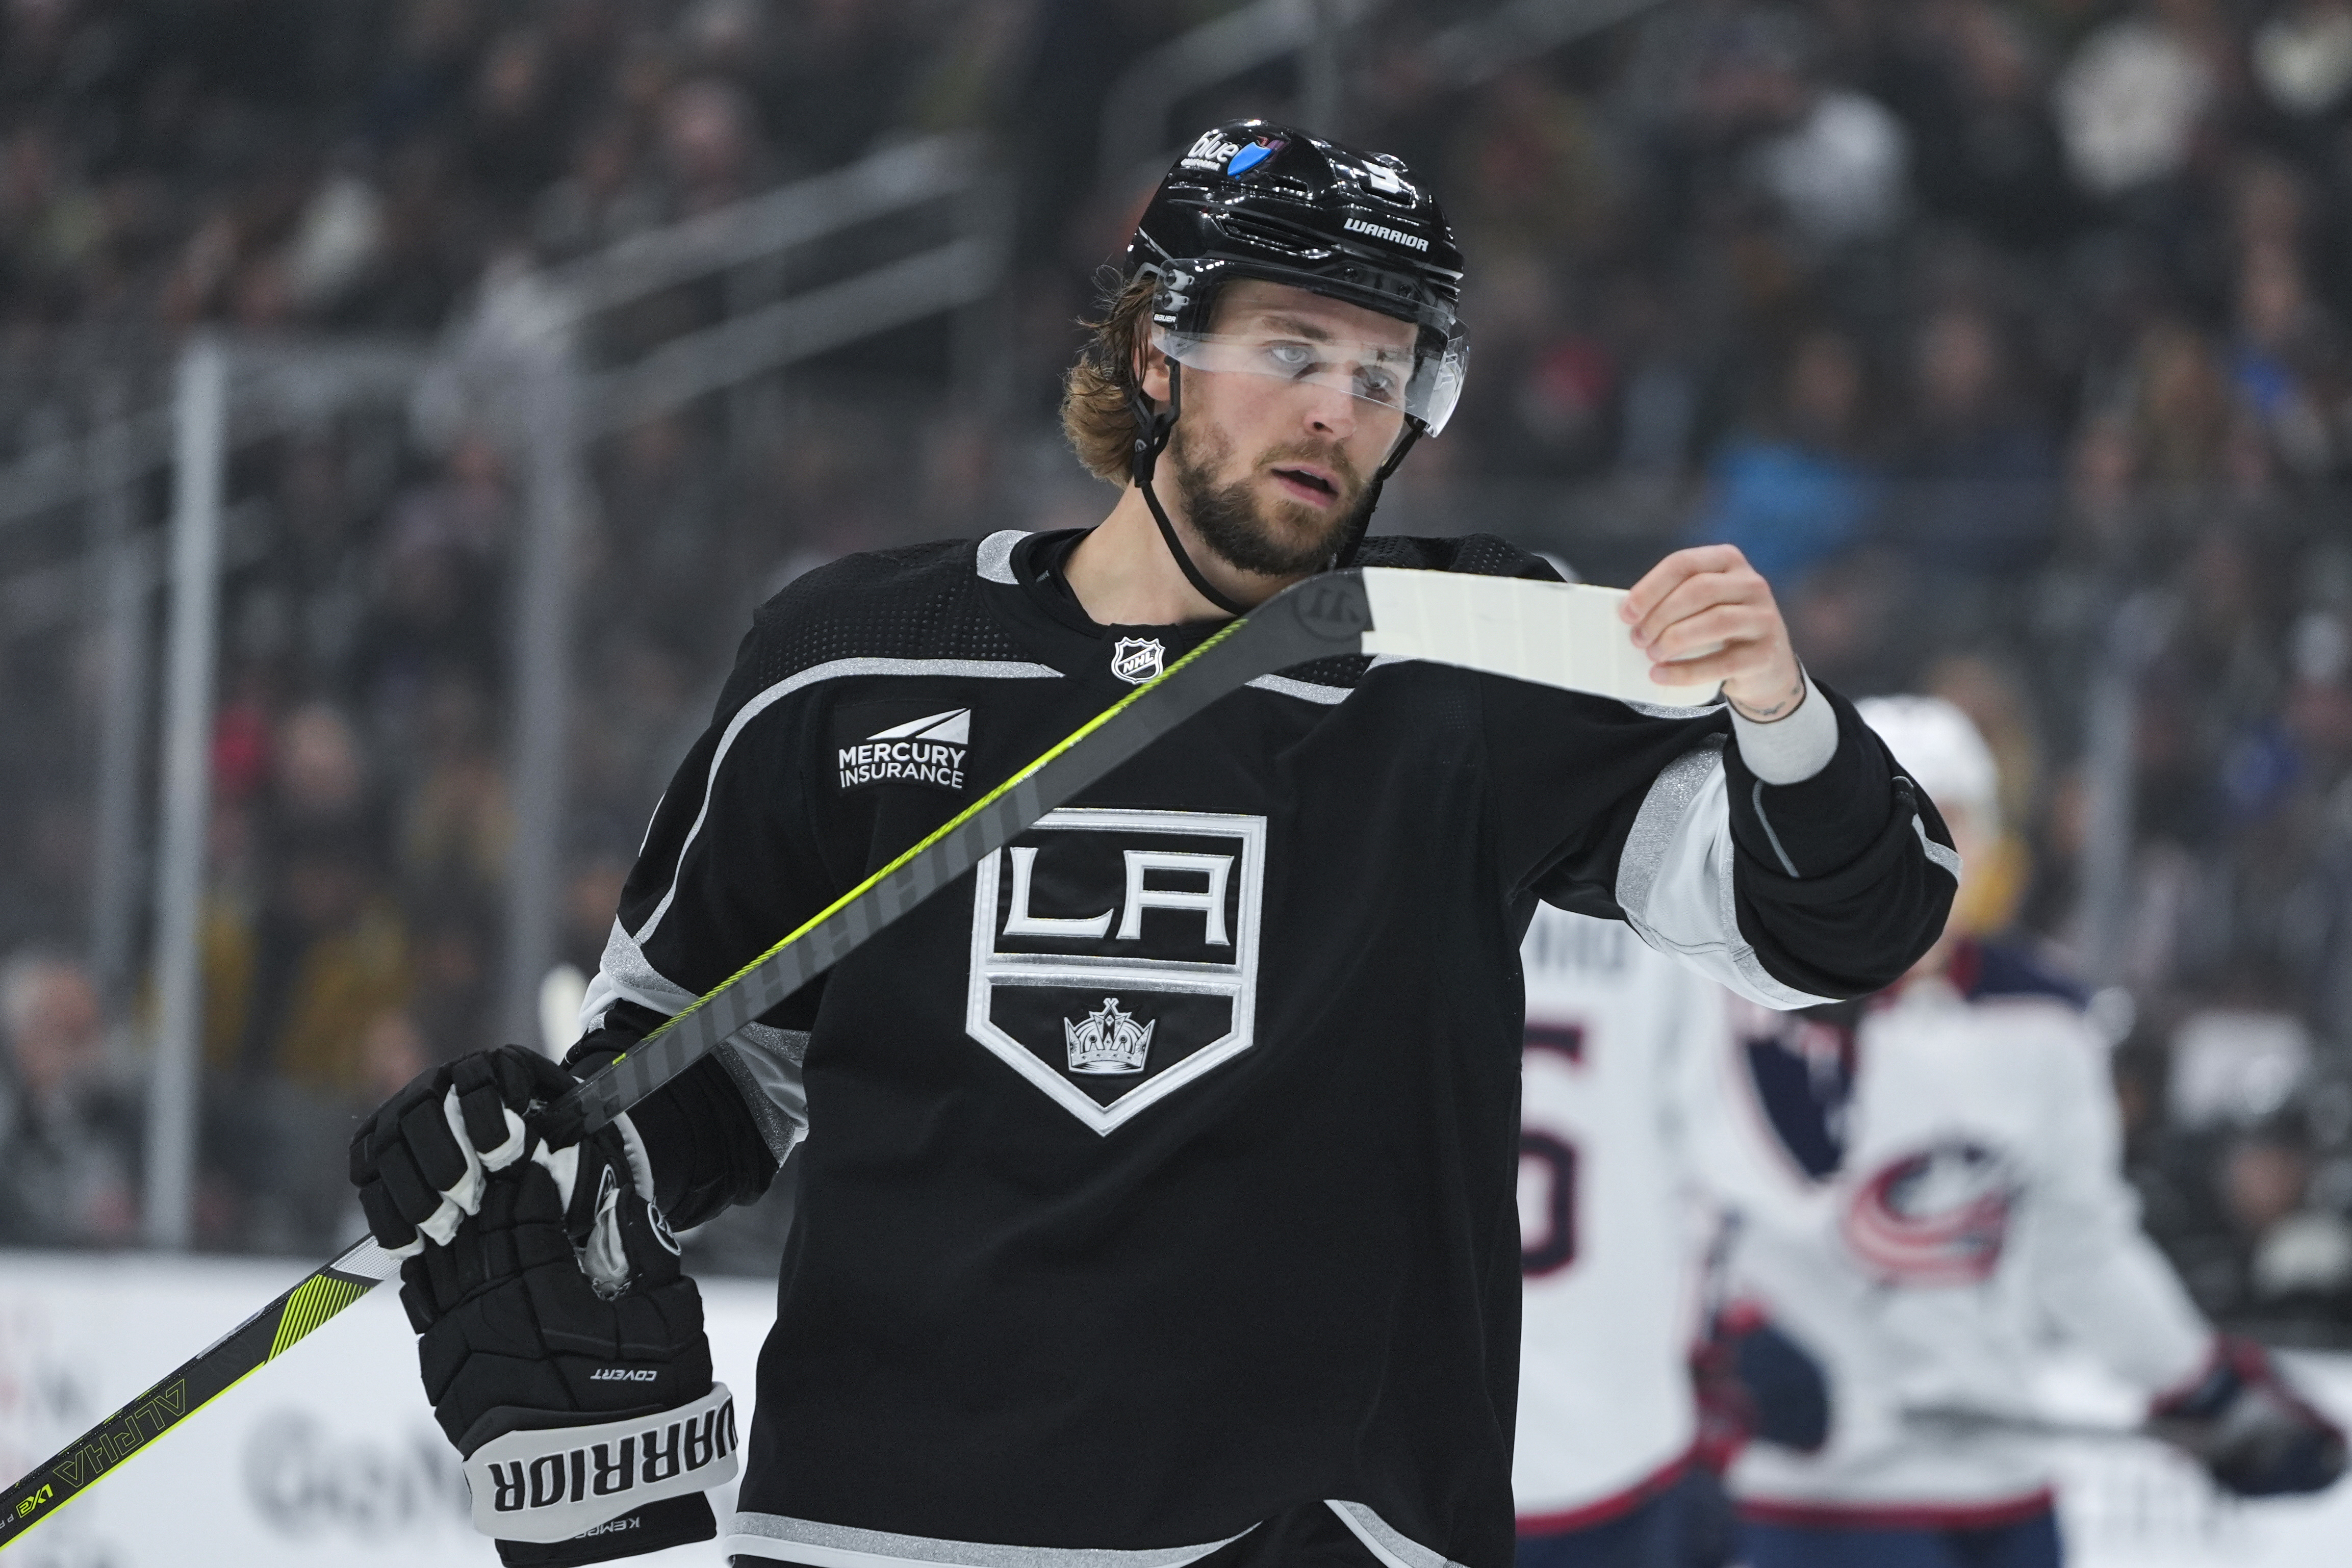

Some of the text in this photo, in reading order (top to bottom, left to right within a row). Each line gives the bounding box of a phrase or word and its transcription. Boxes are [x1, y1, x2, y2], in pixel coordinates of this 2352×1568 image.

[1187, 131, 1240, 162] blue
[1344, 218, 1429, 252] WARRIOR
[1123, 652, 1154, 674] NHL
[839, 742, 966, 769] MERCURY
[839, 762, 964, 789] INSURANCE
[1003, 846, 1235, 946] LA
[590, 1368, 658, 1382] COVERT
[53, 1378, 185, 1488] ALPHA
[485, 1393, 738, 1513] WARRIOR
